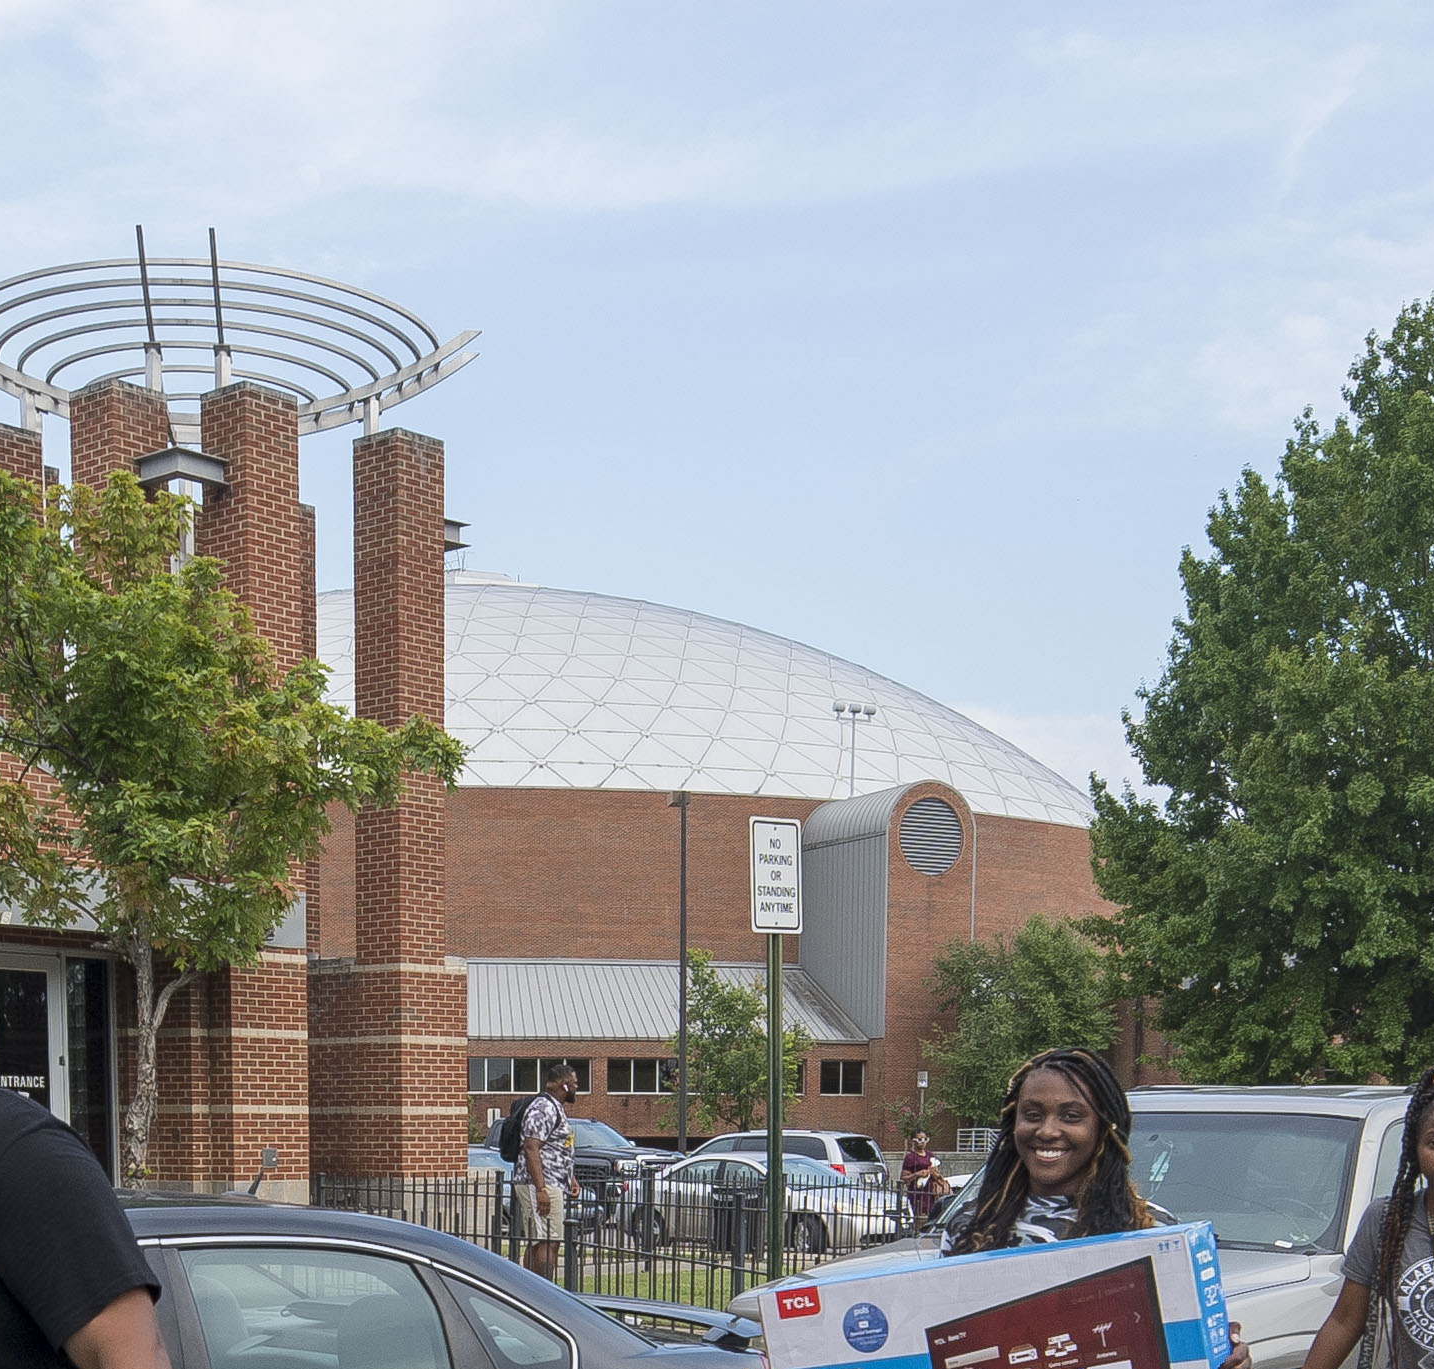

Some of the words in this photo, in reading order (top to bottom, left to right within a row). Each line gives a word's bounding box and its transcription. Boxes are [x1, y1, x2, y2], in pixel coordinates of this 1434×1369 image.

[769, 838, 781, 850] NO
[759, 853, 793, 866] PARKING
[770, 870, 782, 881] OR
[757, 885, 796, 898] STANDING
[760, 901, 794, 913] ANYTIME
[782, 1295, 815, 1311] TCL
